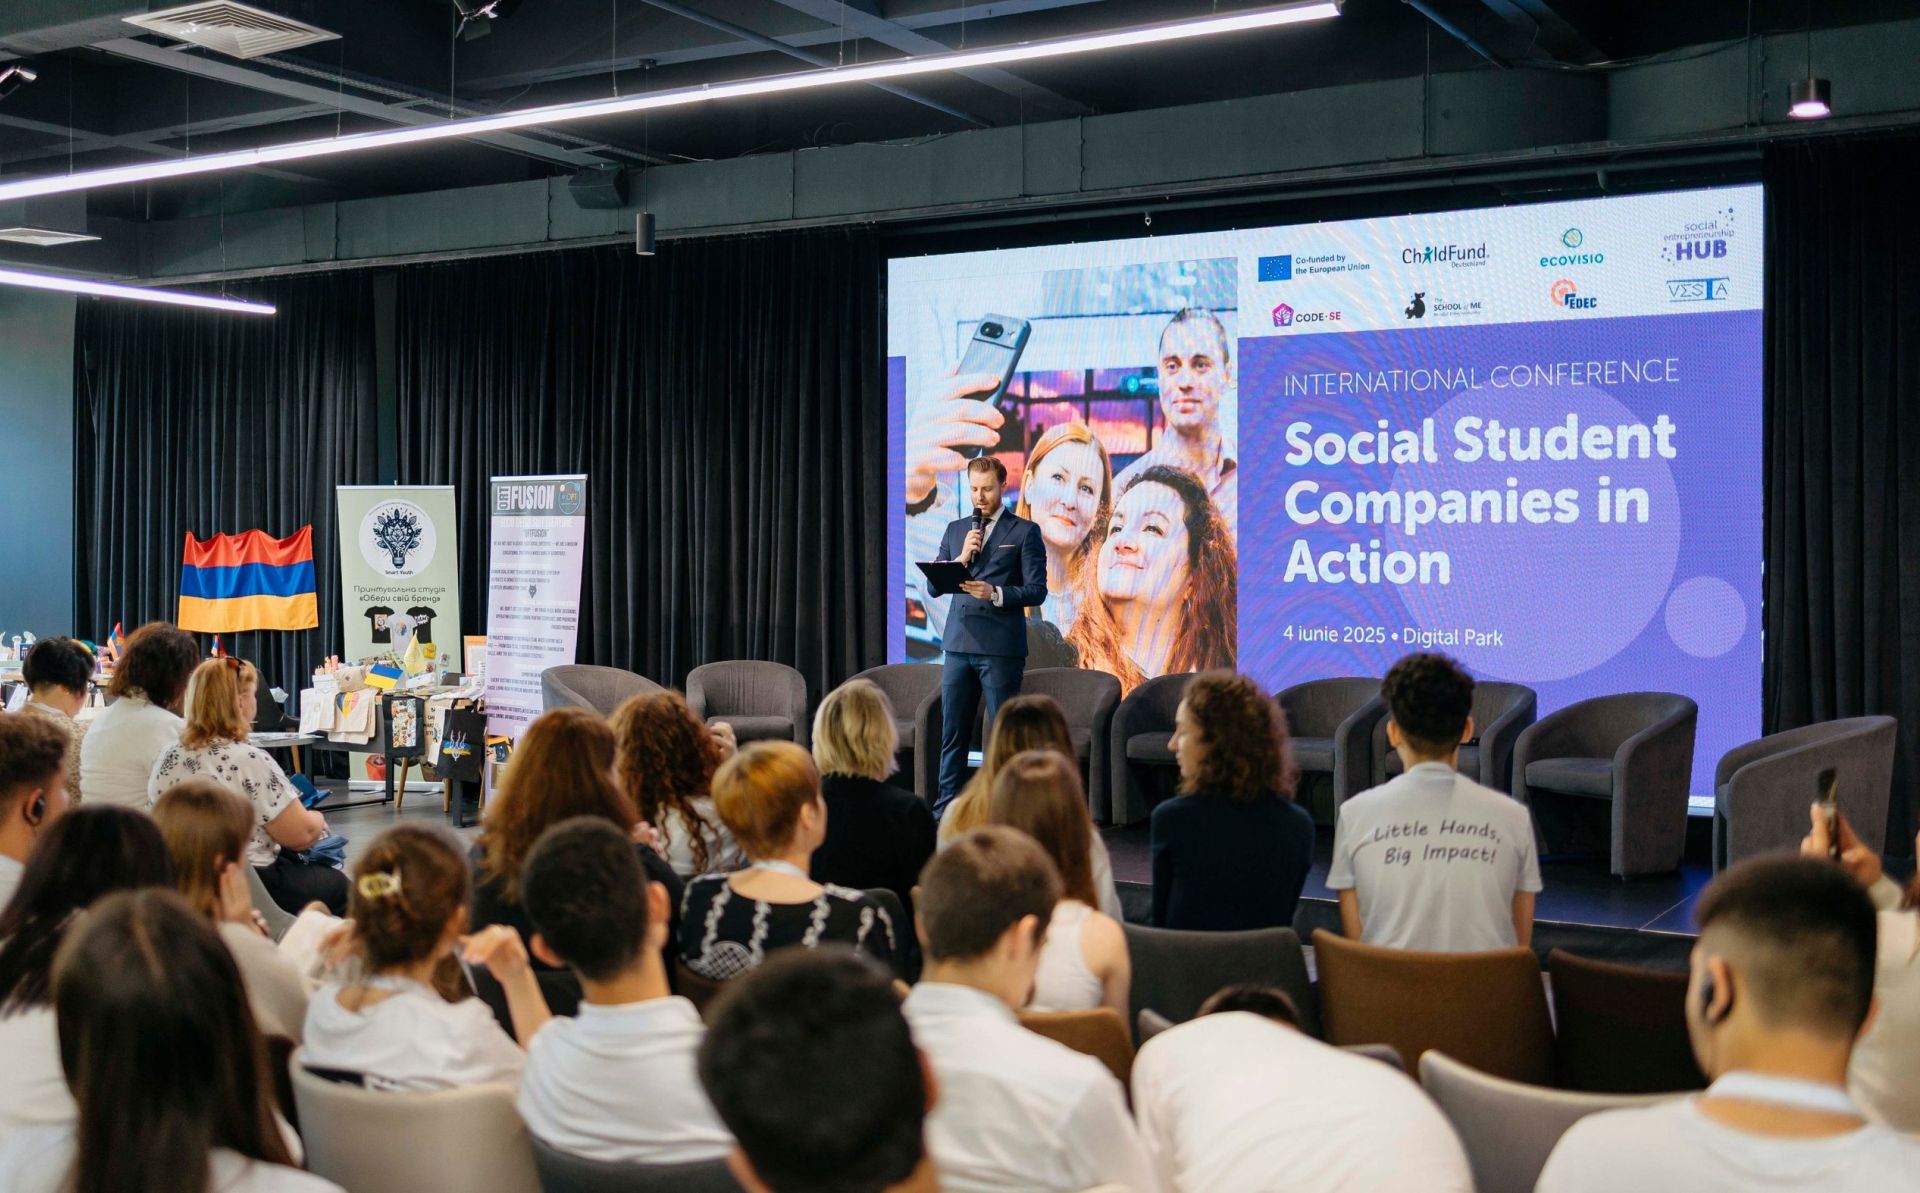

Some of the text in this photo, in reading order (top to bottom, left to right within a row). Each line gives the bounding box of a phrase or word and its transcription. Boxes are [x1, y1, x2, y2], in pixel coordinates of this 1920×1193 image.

[1664, 229, 1735, 241] entrepreneurship
[1684, 220, 1717, 231] social
[1295, 254, 1346, 264] Co-funded by
[1676, 239, 1727, 261] HUB
[1295, 262, 1370, 275] the European Union
[1433, 303, 1462, 311] SCHOOL
[1564, 293, 1597, 309] FEDEC
[1284, 358, 1680, 396] INTERNATIONAL CONFERENCE
[1285, 413, 1677, 466] Social Student
[510, 485, 555, 510] FUSION
[1285, 476, 1649, 535] Companies in
[1284, 539, 1451, 584] Action
[392, 594, 410, 602] свій
[418, 586, 446, 594] студія
[1283, 625, 1504, 649] 4 iunie 2025 Digital Park
[1374, 819, 1501, 844] Little Hands,
[1384, 844, 1497, 866] Big Impact!
